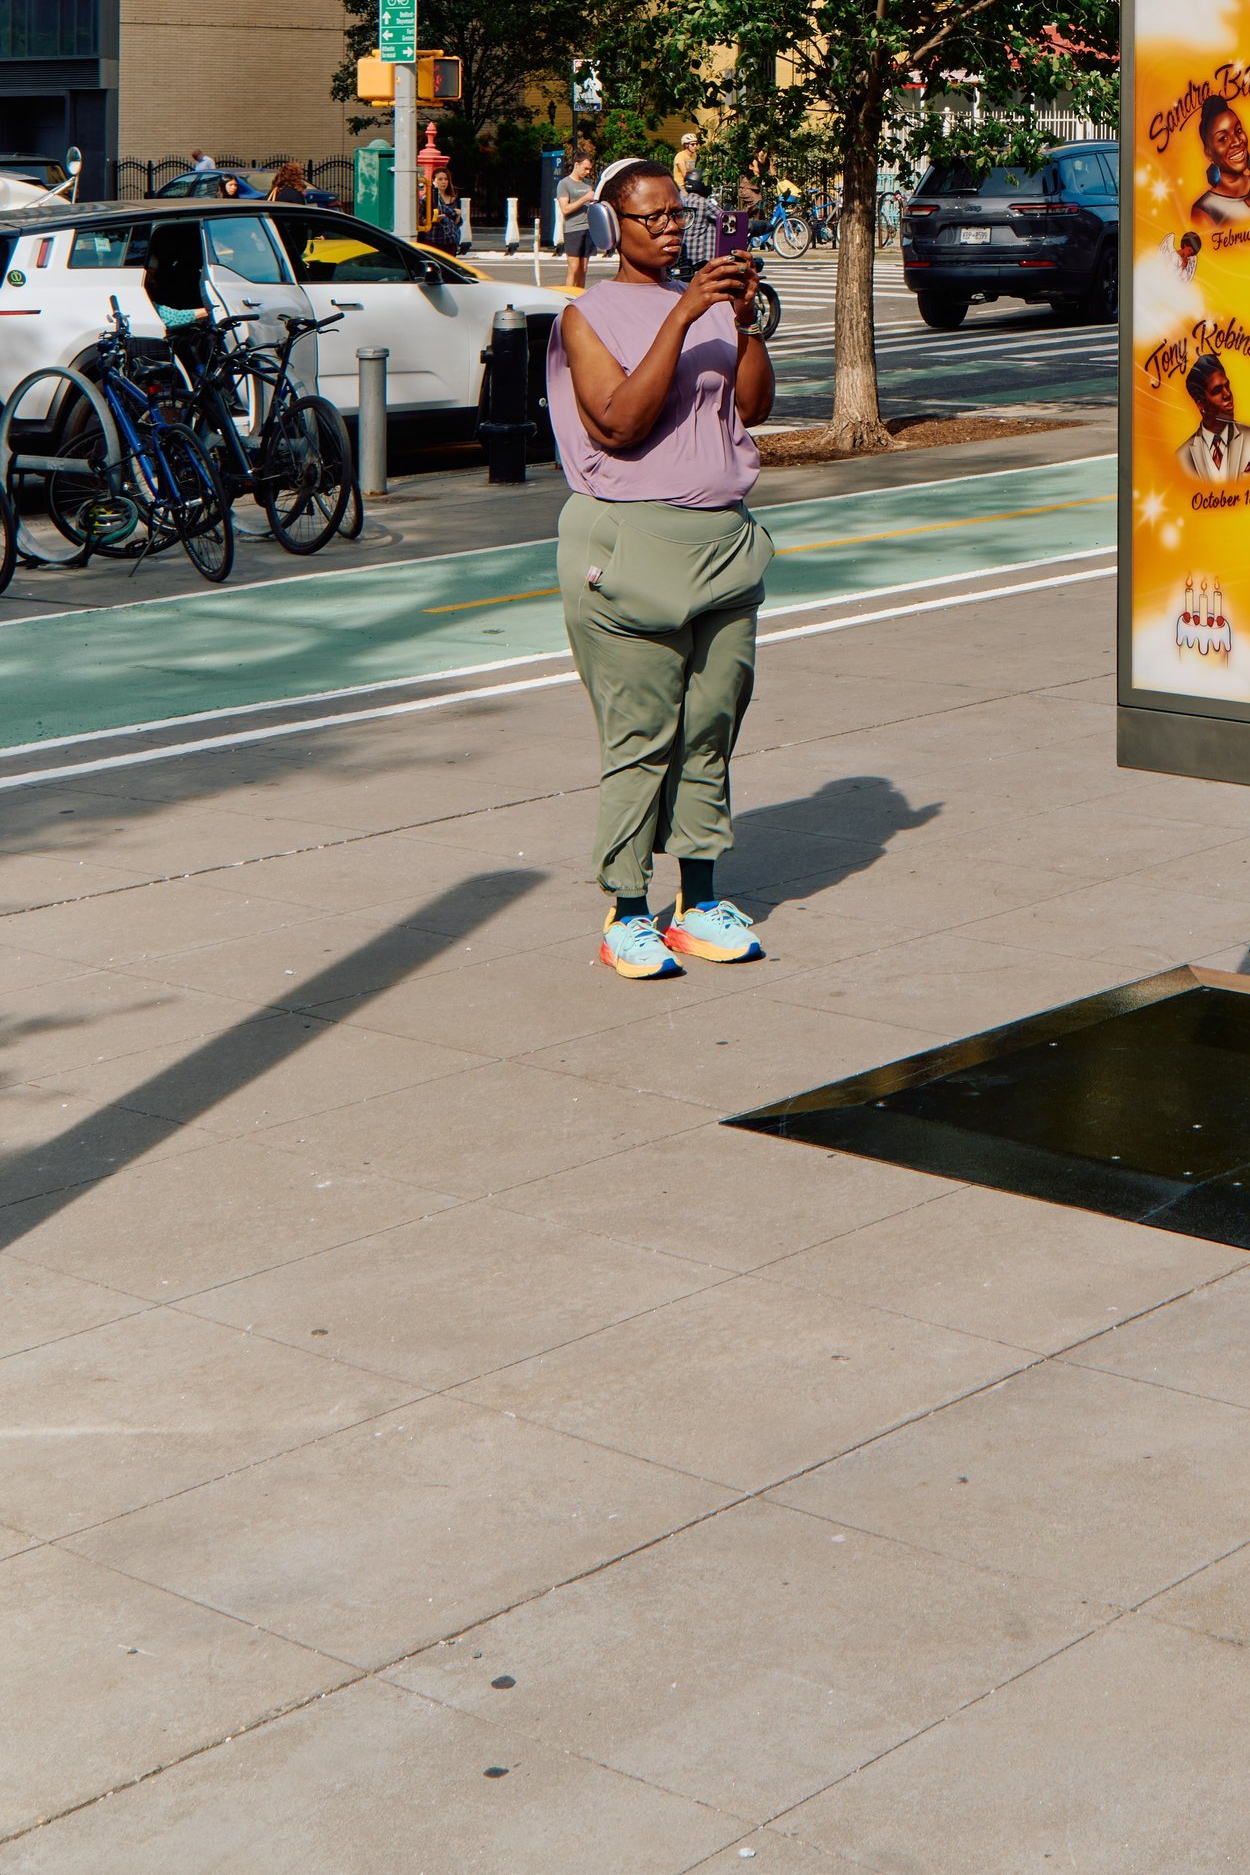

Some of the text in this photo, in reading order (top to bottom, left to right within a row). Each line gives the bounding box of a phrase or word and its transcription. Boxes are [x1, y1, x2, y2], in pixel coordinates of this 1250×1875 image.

[1149, 79, 1213, 154] Sandra
[1144, 338, 1189, 390] Tony
[1191, 489, 1240, 511] October
